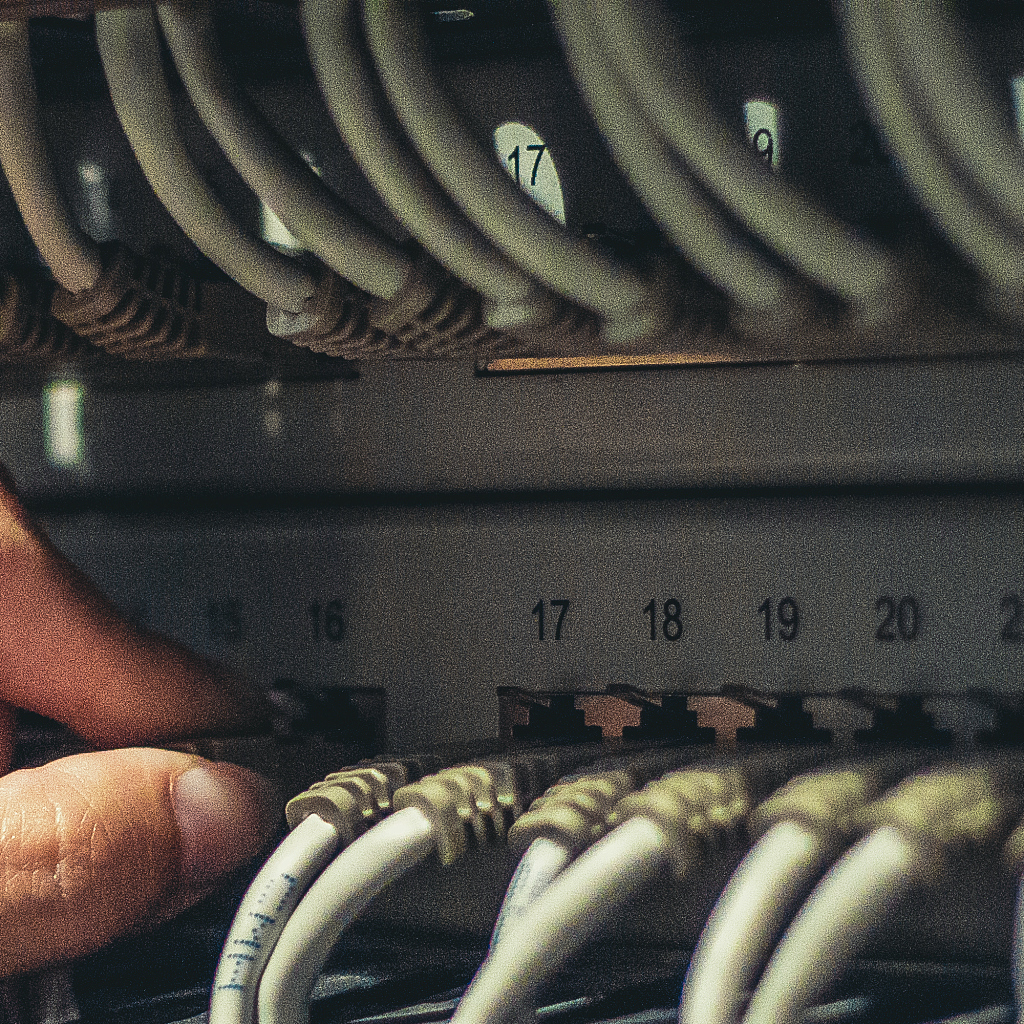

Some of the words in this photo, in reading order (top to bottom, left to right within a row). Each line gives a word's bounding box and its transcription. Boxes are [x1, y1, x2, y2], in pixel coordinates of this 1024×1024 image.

[507, 144, 548, 189] 17
[752, 127, 774, 166] 9
[308, 598, 348, 643] 16
[531, 598, 571, 641] 17
[643, 597, 684, 642] 18
[758, 597, 801, 642] 19
[875, 595, 923, 643] 20
[1000, 594, 1024, 643] 2
